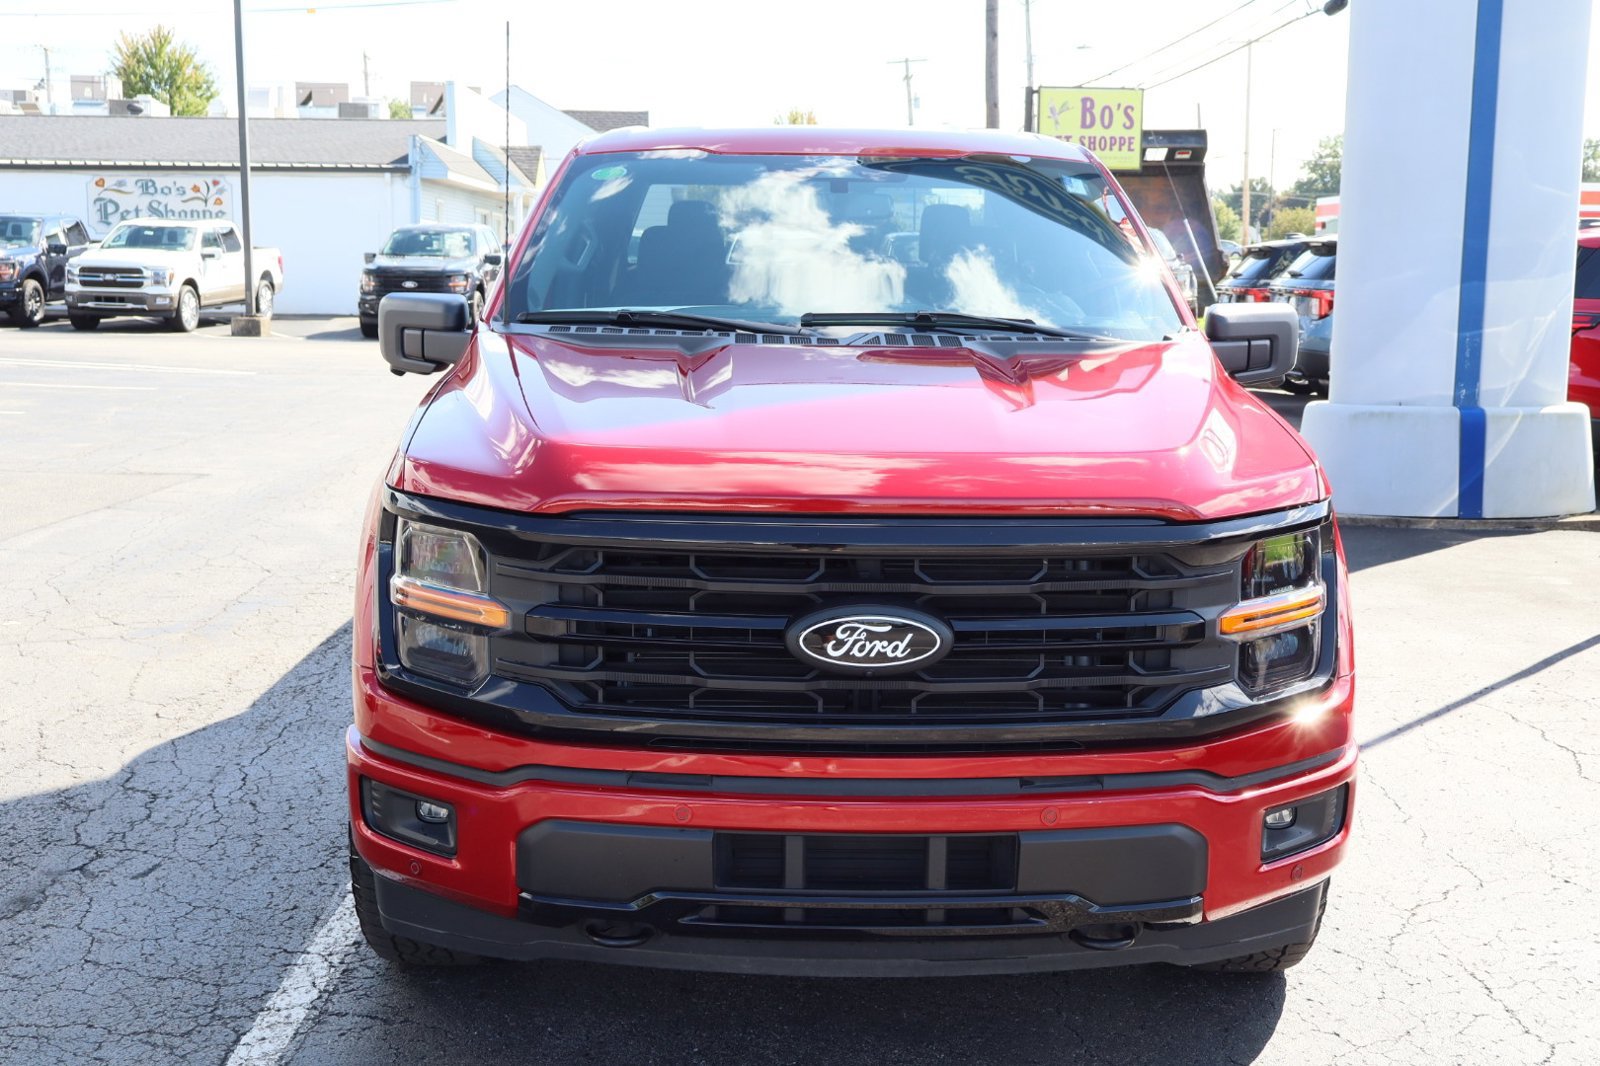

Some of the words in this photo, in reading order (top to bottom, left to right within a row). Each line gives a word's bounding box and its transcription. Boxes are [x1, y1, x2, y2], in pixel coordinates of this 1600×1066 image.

[1080, 96, 1135, 130] Bo's
[1079, 135, 1135, 152] SHOPPE
[135, 178, 187, 196] Bo's
[93, 197, 142, 225] Pet
[827, 623, 914, 658] Ford
